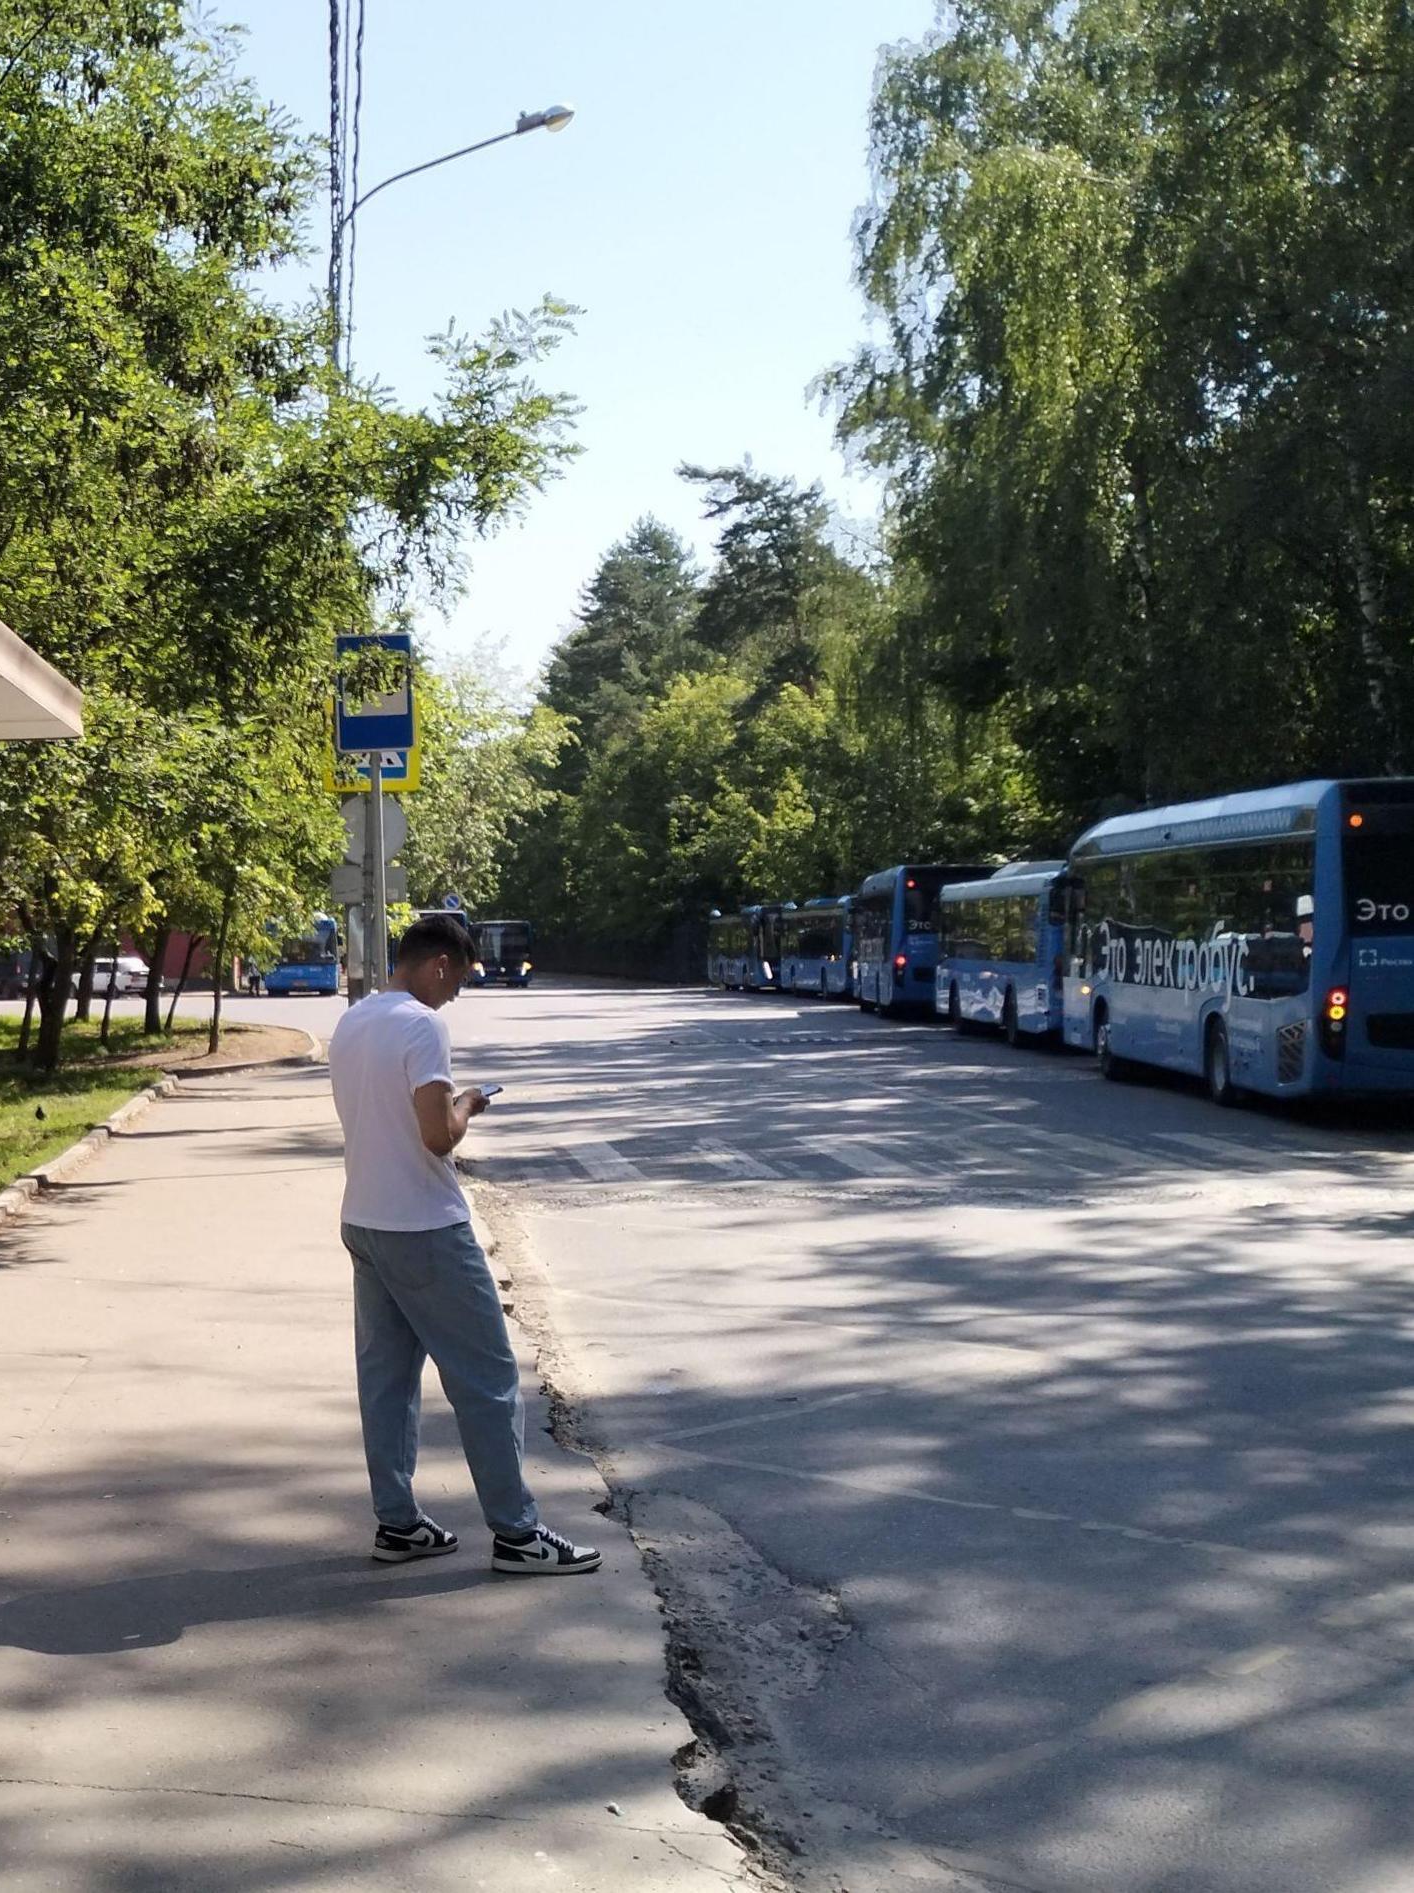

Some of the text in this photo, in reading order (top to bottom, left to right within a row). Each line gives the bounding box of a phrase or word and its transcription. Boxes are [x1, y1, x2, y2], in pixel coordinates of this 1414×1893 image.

[1356, 898, 1410, 921] Это
[1100, 919, 1255, 1012] Это электробус.
